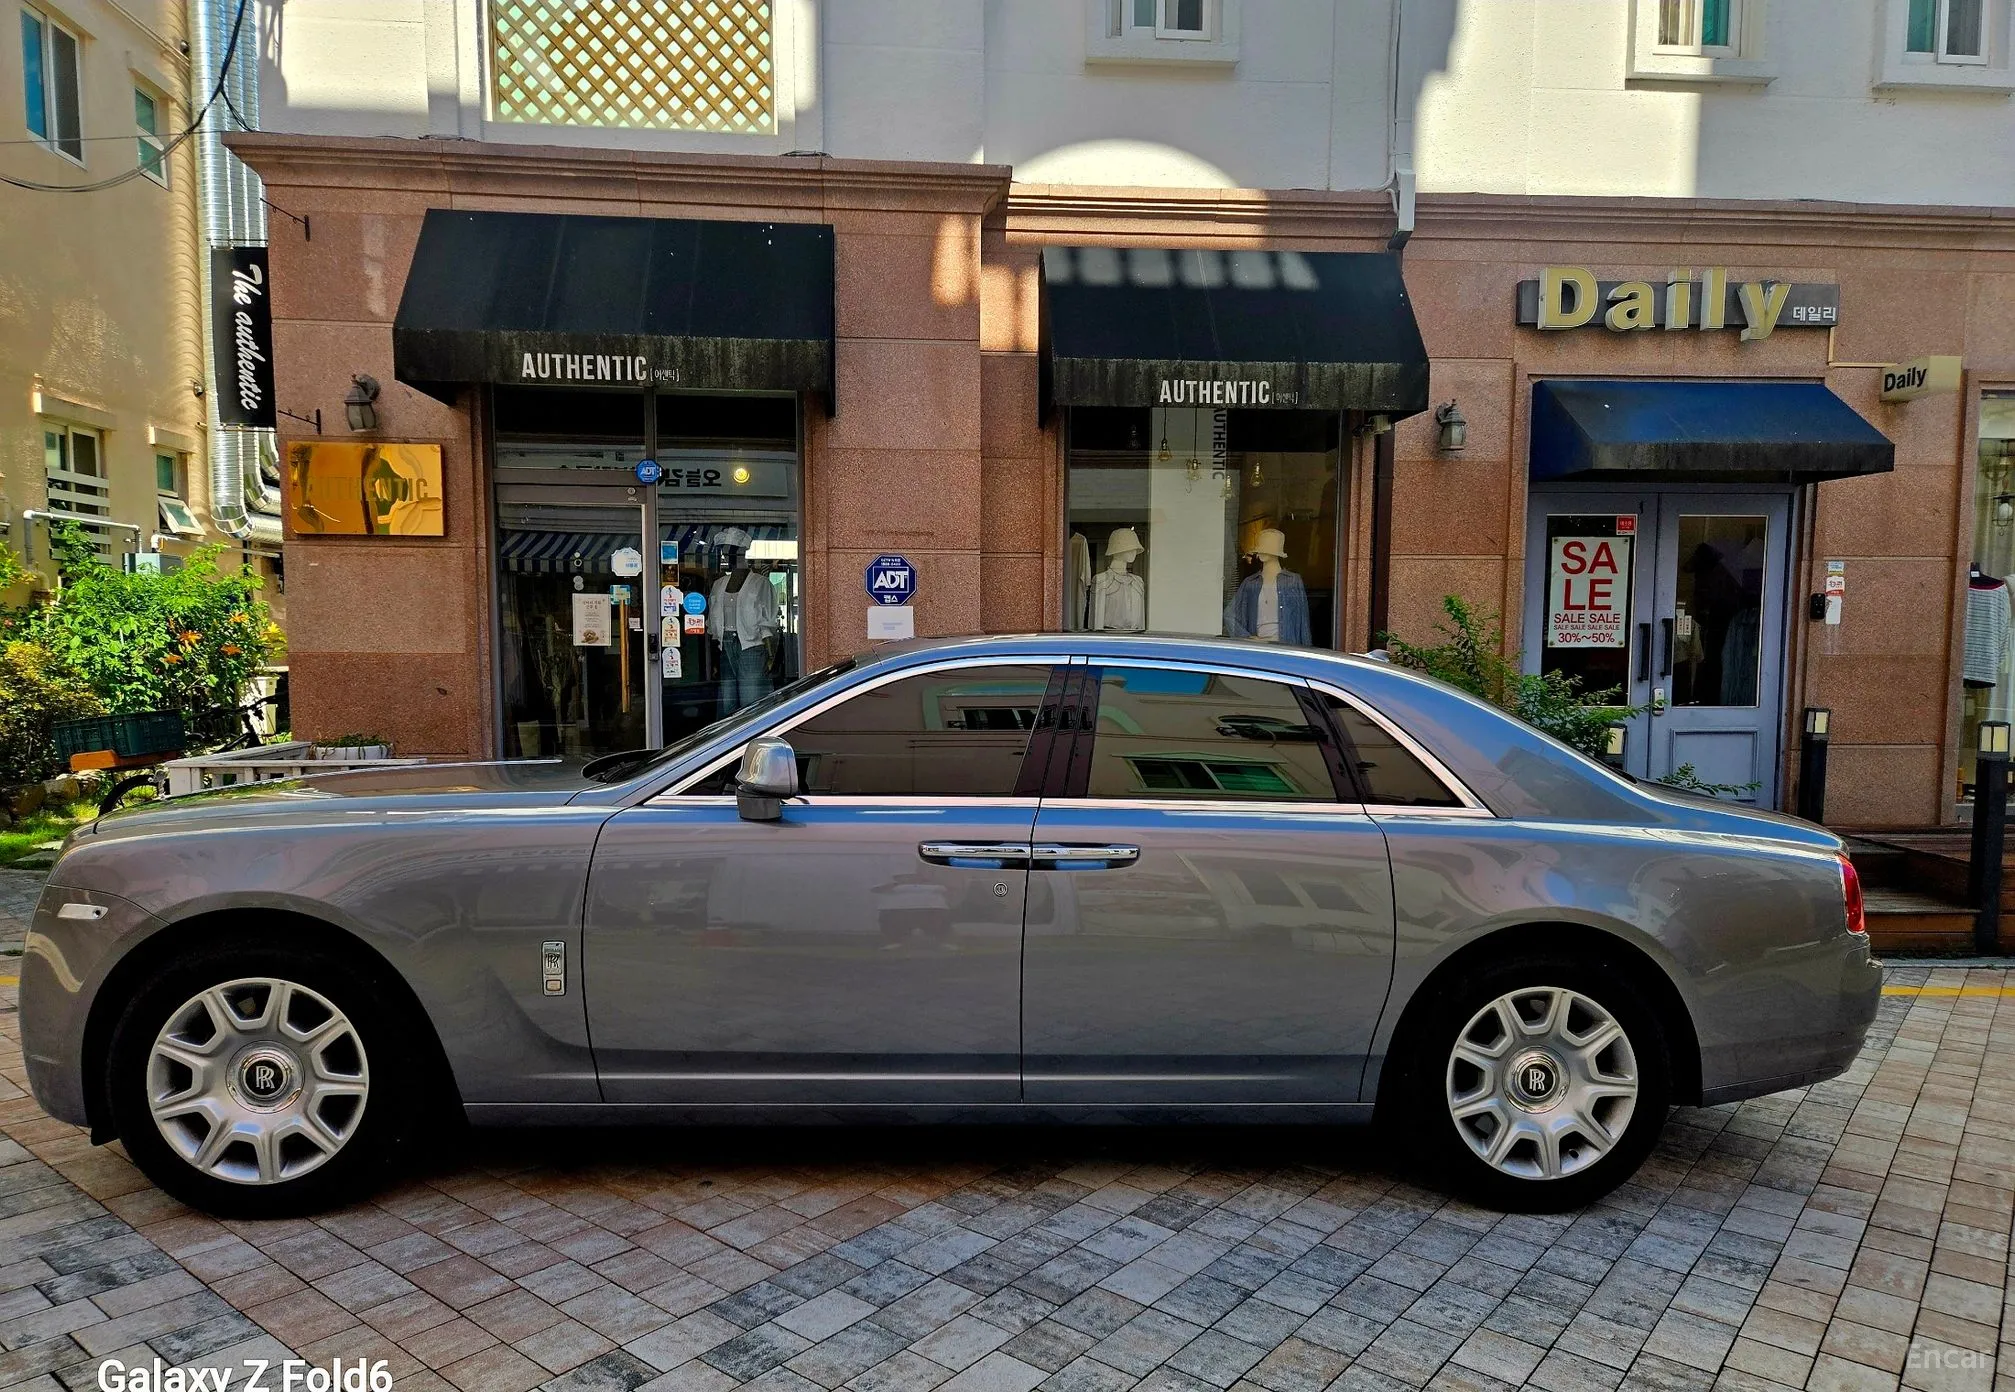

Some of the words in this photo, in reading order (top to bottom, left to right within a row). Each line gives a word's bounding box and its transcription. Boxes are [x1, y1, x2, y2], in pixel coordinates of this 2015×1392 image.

[232, 264, 263, 305] The
[1538, 267, 1792, 341] Daily
[1793, 306, 1836, 321] 데일리
[235, 311, 266, 410] authentic
[521, 353, 647, 381] AUTHENTIC
[1159, 379, 1270, 404] AUTHENTIC
[1884, 367, 1928, 393] Daily
[639, 467, 657, 477] ADT
[1561, 541, 1619, 575] SA
[874, 570, 909, 589] ADT
[1563, 578, 1613, 611] LE
[1554, 613, 1585, 624] SALE
[1589, 613, 1621, 624] SALE
